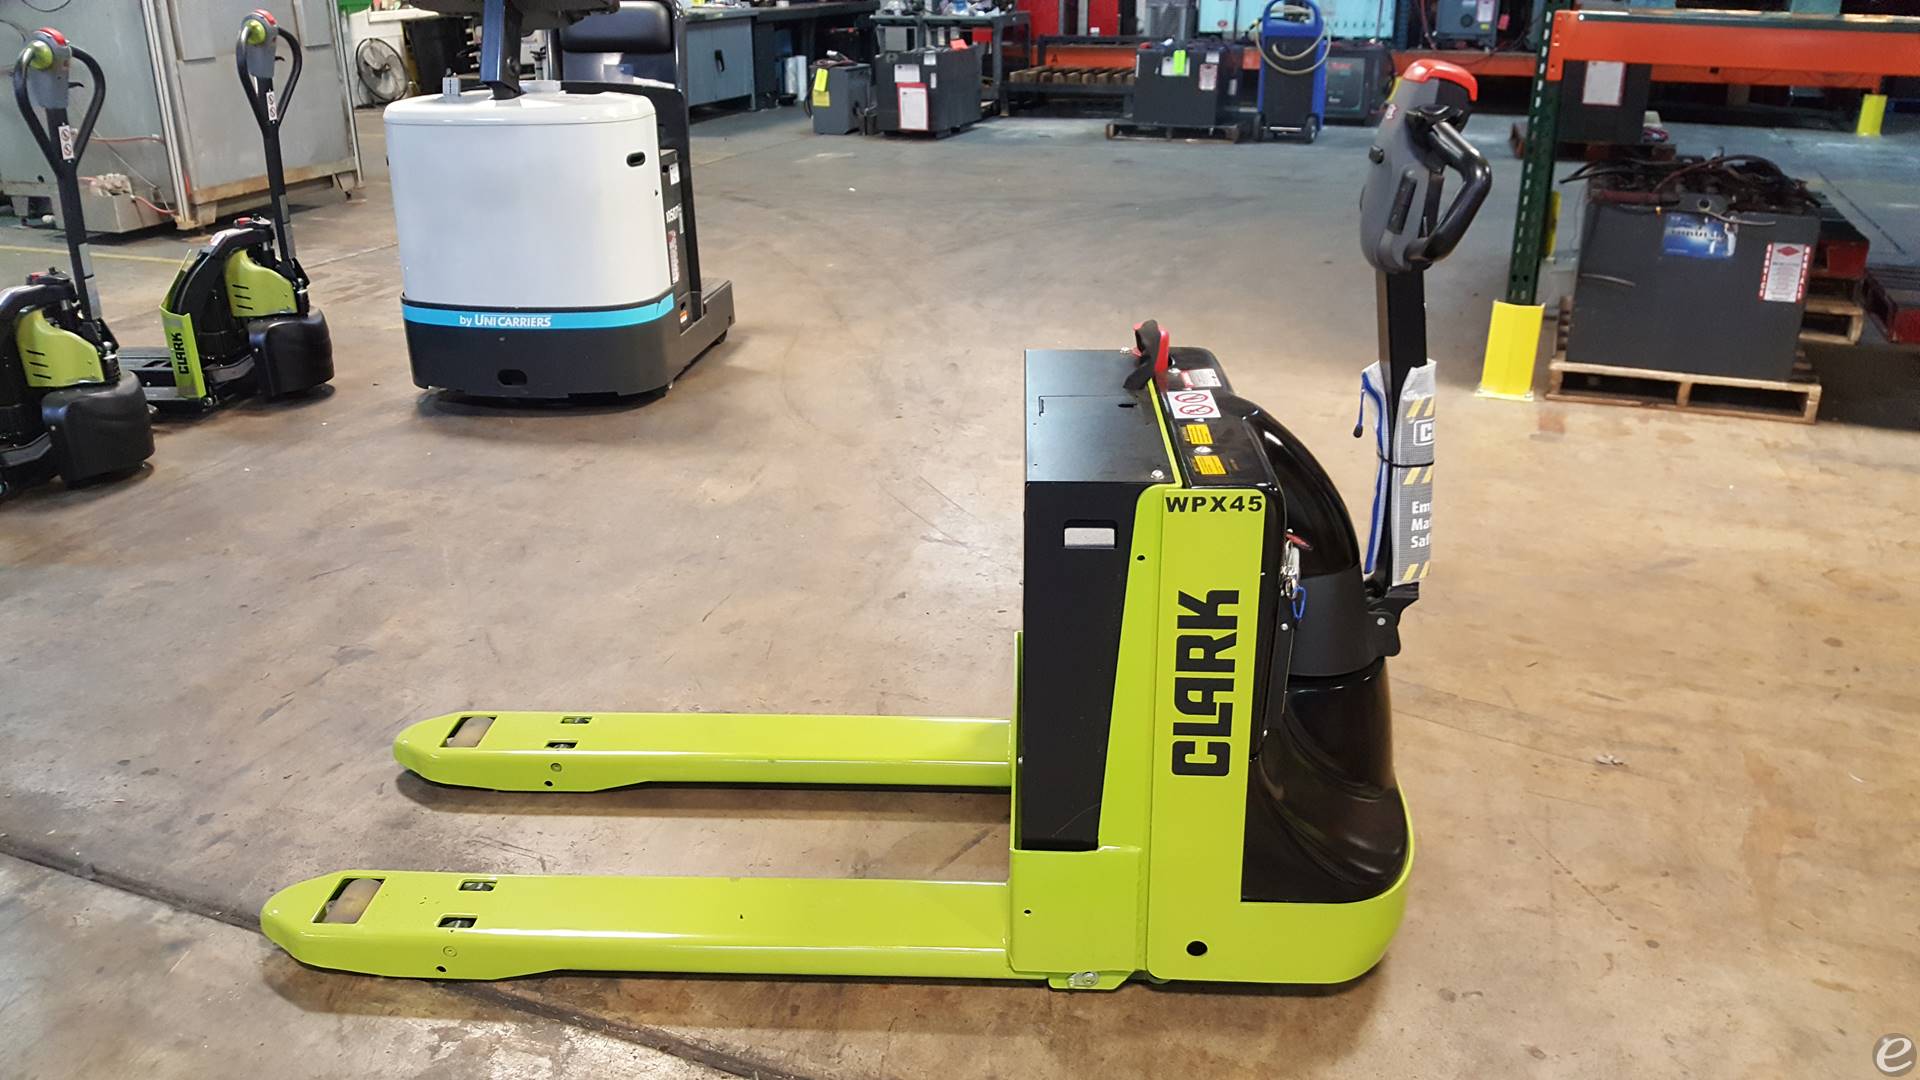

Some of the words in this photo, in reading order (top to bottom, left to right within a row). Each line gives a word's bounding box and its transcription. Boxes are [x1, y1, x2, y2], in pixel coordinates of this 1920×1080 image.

[460, 315, 472, 327] by
[171, 332, 190, 375] CLARK
[1165, 495, 1263, 513] WPX45
[1171, 589, 1240, 777] CLARK
